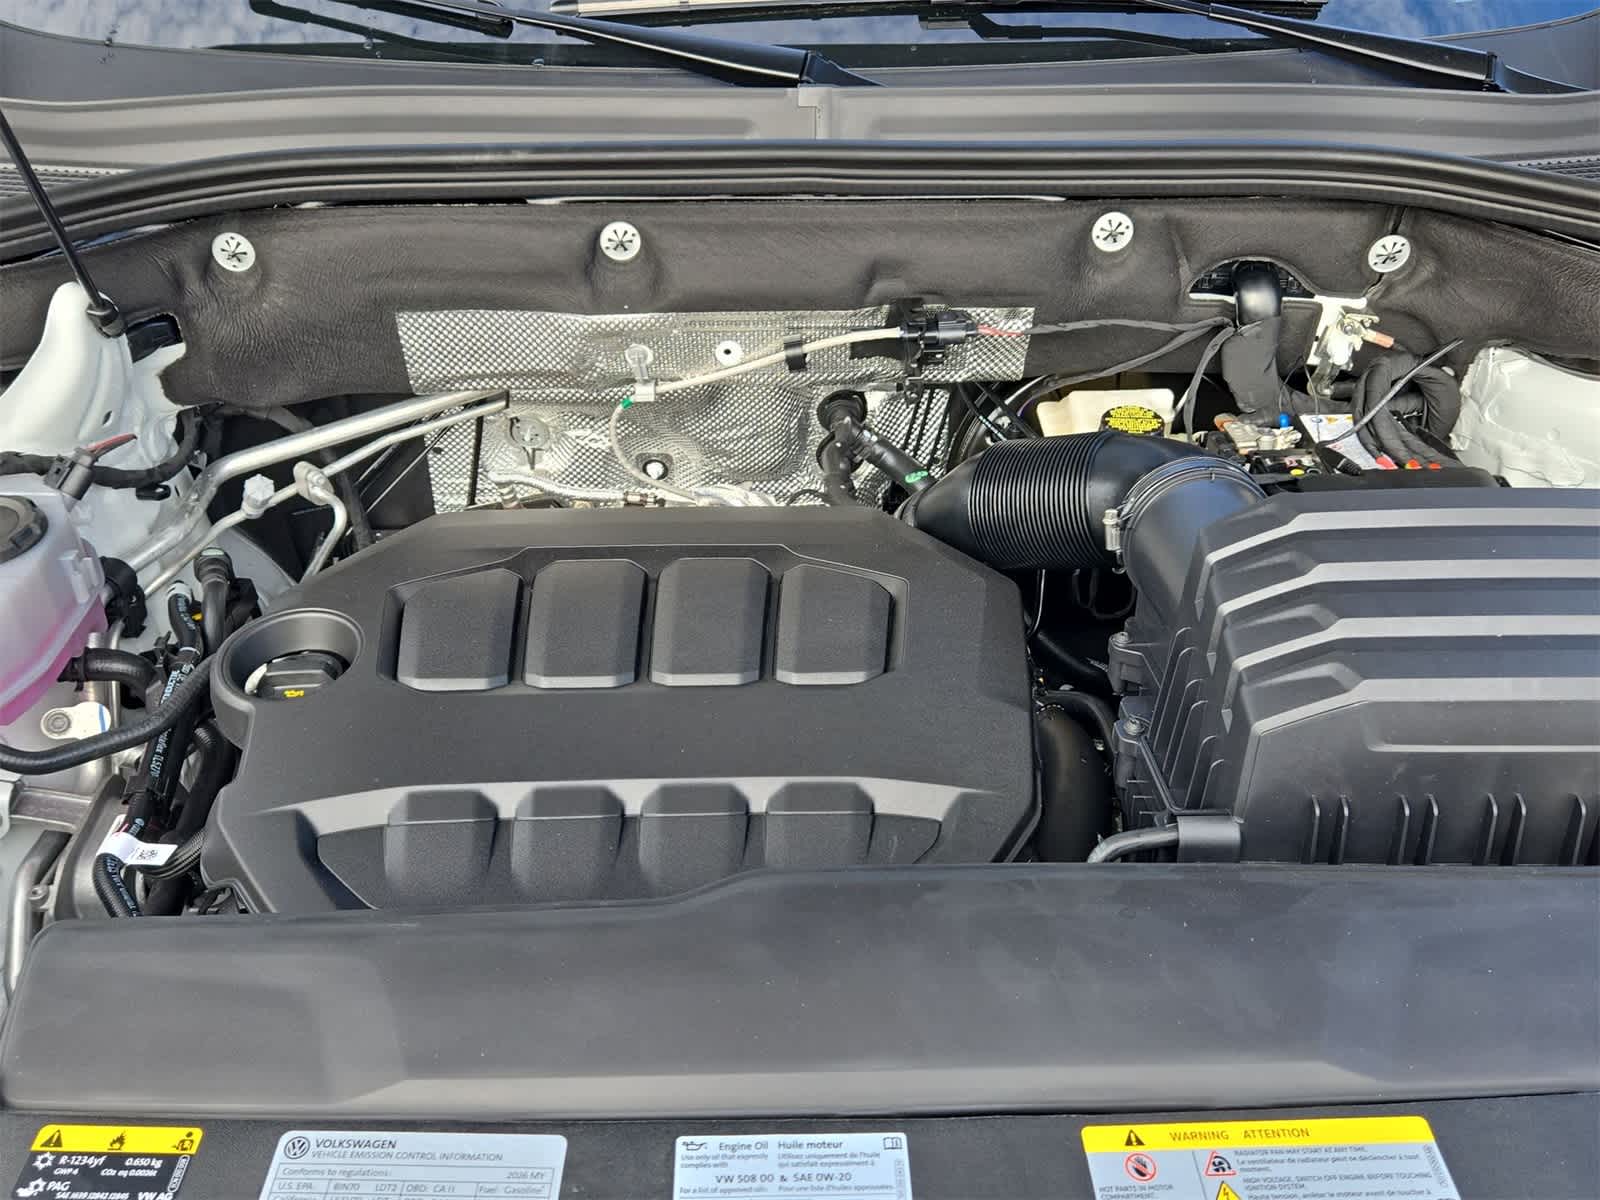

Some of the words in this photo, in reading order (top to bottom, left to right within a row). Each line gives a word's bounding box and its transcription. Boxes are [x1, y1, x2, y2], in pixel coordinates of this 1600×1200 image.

[1168, 1130, 1230, 1141] WARNING
[1243, 1127, 1310, 1139] ATTENTION
[315, 1138, 397, 1149] VOLKSWAGEN
[719, 1142, 752, 1152] Engine
[754, 1141, 769, 1150] Oil
[778, 1140, 804, 1149] Huile
[806, 1141, 843, 1149] moteur
[312, 1150, 349, 1158] VEHICLE
[350, 1150, 393, 1159] EMISSION
[394, 1151, 438, 1160] CONTROL
[439, 1152, 504, 1161] INFORMATION
[58, 1155, 107, 1168] R-1234yf
[124, 1157, 151, 1166] 0.650
[150, 1158, 163, 1169] kg
[282, 1168, 325, 1176] Conforms
[327, 1168, 337, 1176] to
[715, 1175, 735, 1183] VW
[737, 1174, 757, 1183] 508
[759, 1173, 775, 1183] 00
[780, 1174, 787, 1182] &
[793, 1173, 813, 1182] SAE
[46, 1181, 71, 1191] PAG
[138, 1191, 158, 1200] VW
[155, 1192, 174, 1200] AG
